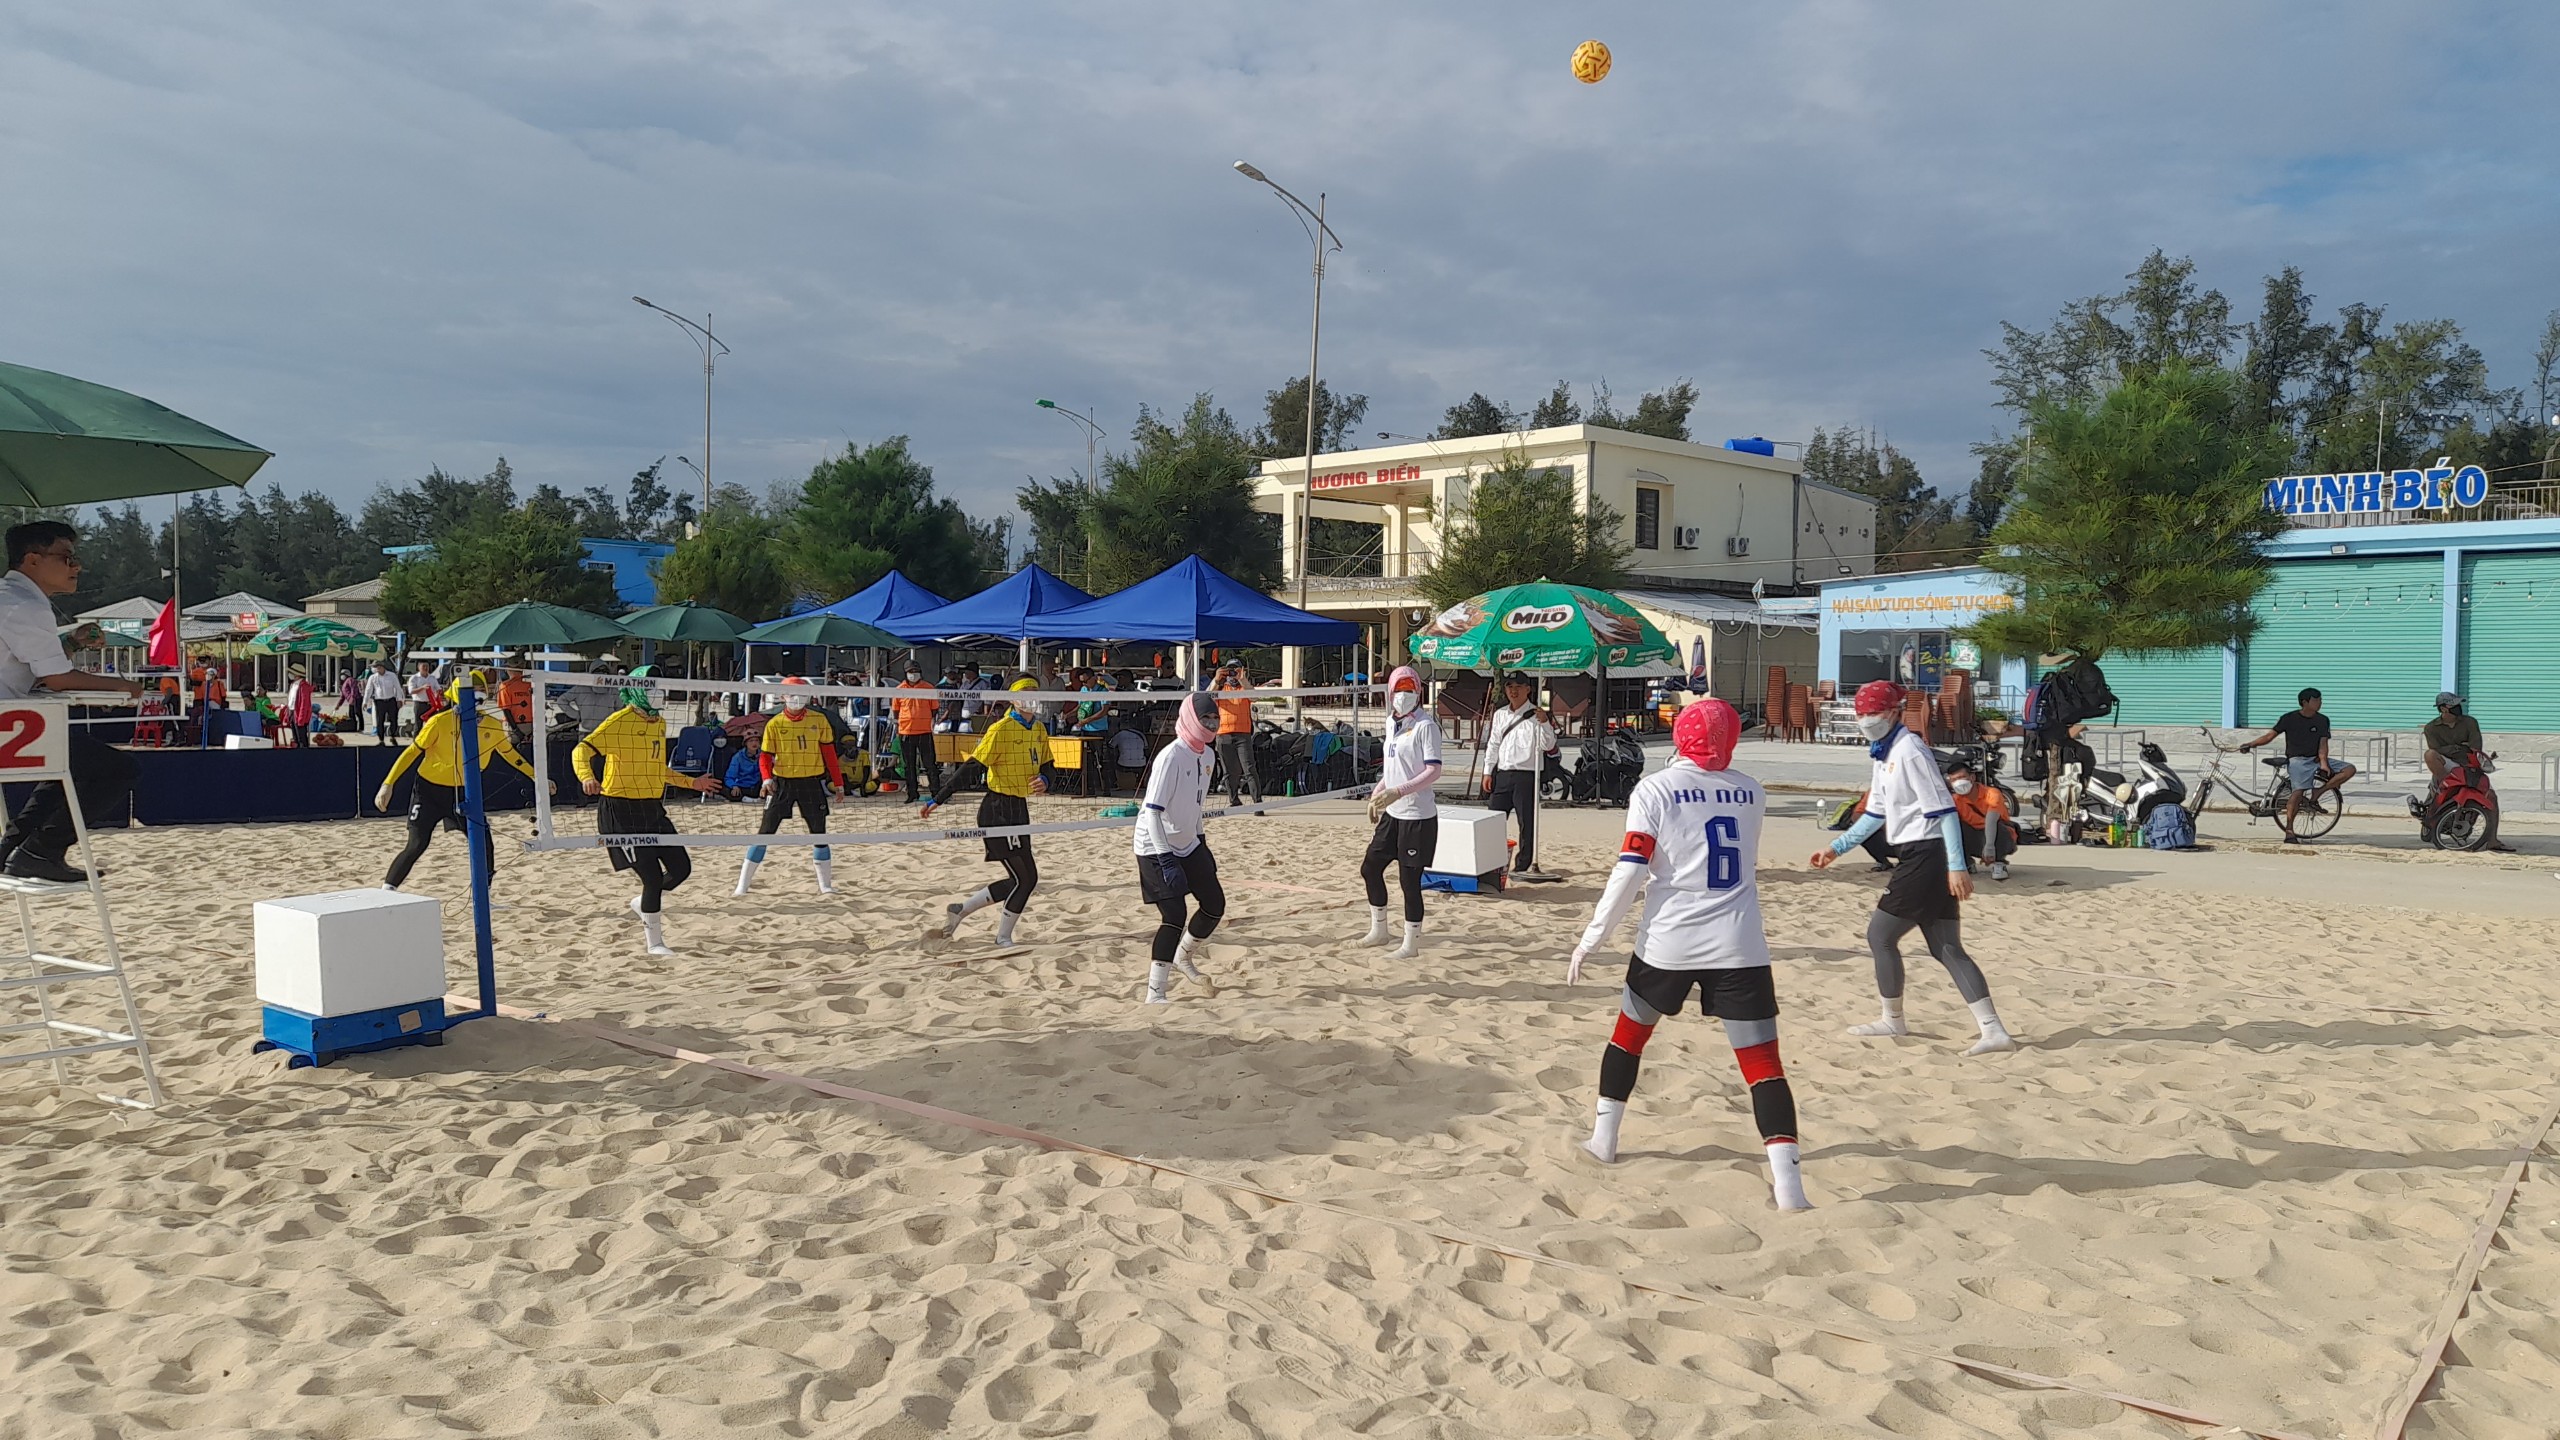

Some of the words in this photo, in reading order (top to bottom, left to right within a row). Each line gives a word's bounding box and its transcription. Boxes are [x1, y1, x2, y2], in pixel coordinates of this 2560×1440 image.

[1376, 462, 1421, 483] BIỂN
[2263, 472, 2384, 515] MINH
[1511, 611, 1568, 625] MILO
[1500, 652, 1522, 661] MILO
[604, 677, 657, 689] MARATHON
[944, 691, 981, 700] MARATHON
[0, 709, 46, 769] 2
[796, 734, 808, 750] 11
[1673, 786, 1706, 805] HÀ
[1715, 787, 1754, 807] NỘI
[410, 804, 421, 821] 5
[1202, 810, 1225, 819] ARATHON
[605, 836, 659, 846] MARATHON
[950, 830, 987, 839] MARATHON
[1627, 833, 1645, 851] C
[1704, 815, 1742, 891] 6
